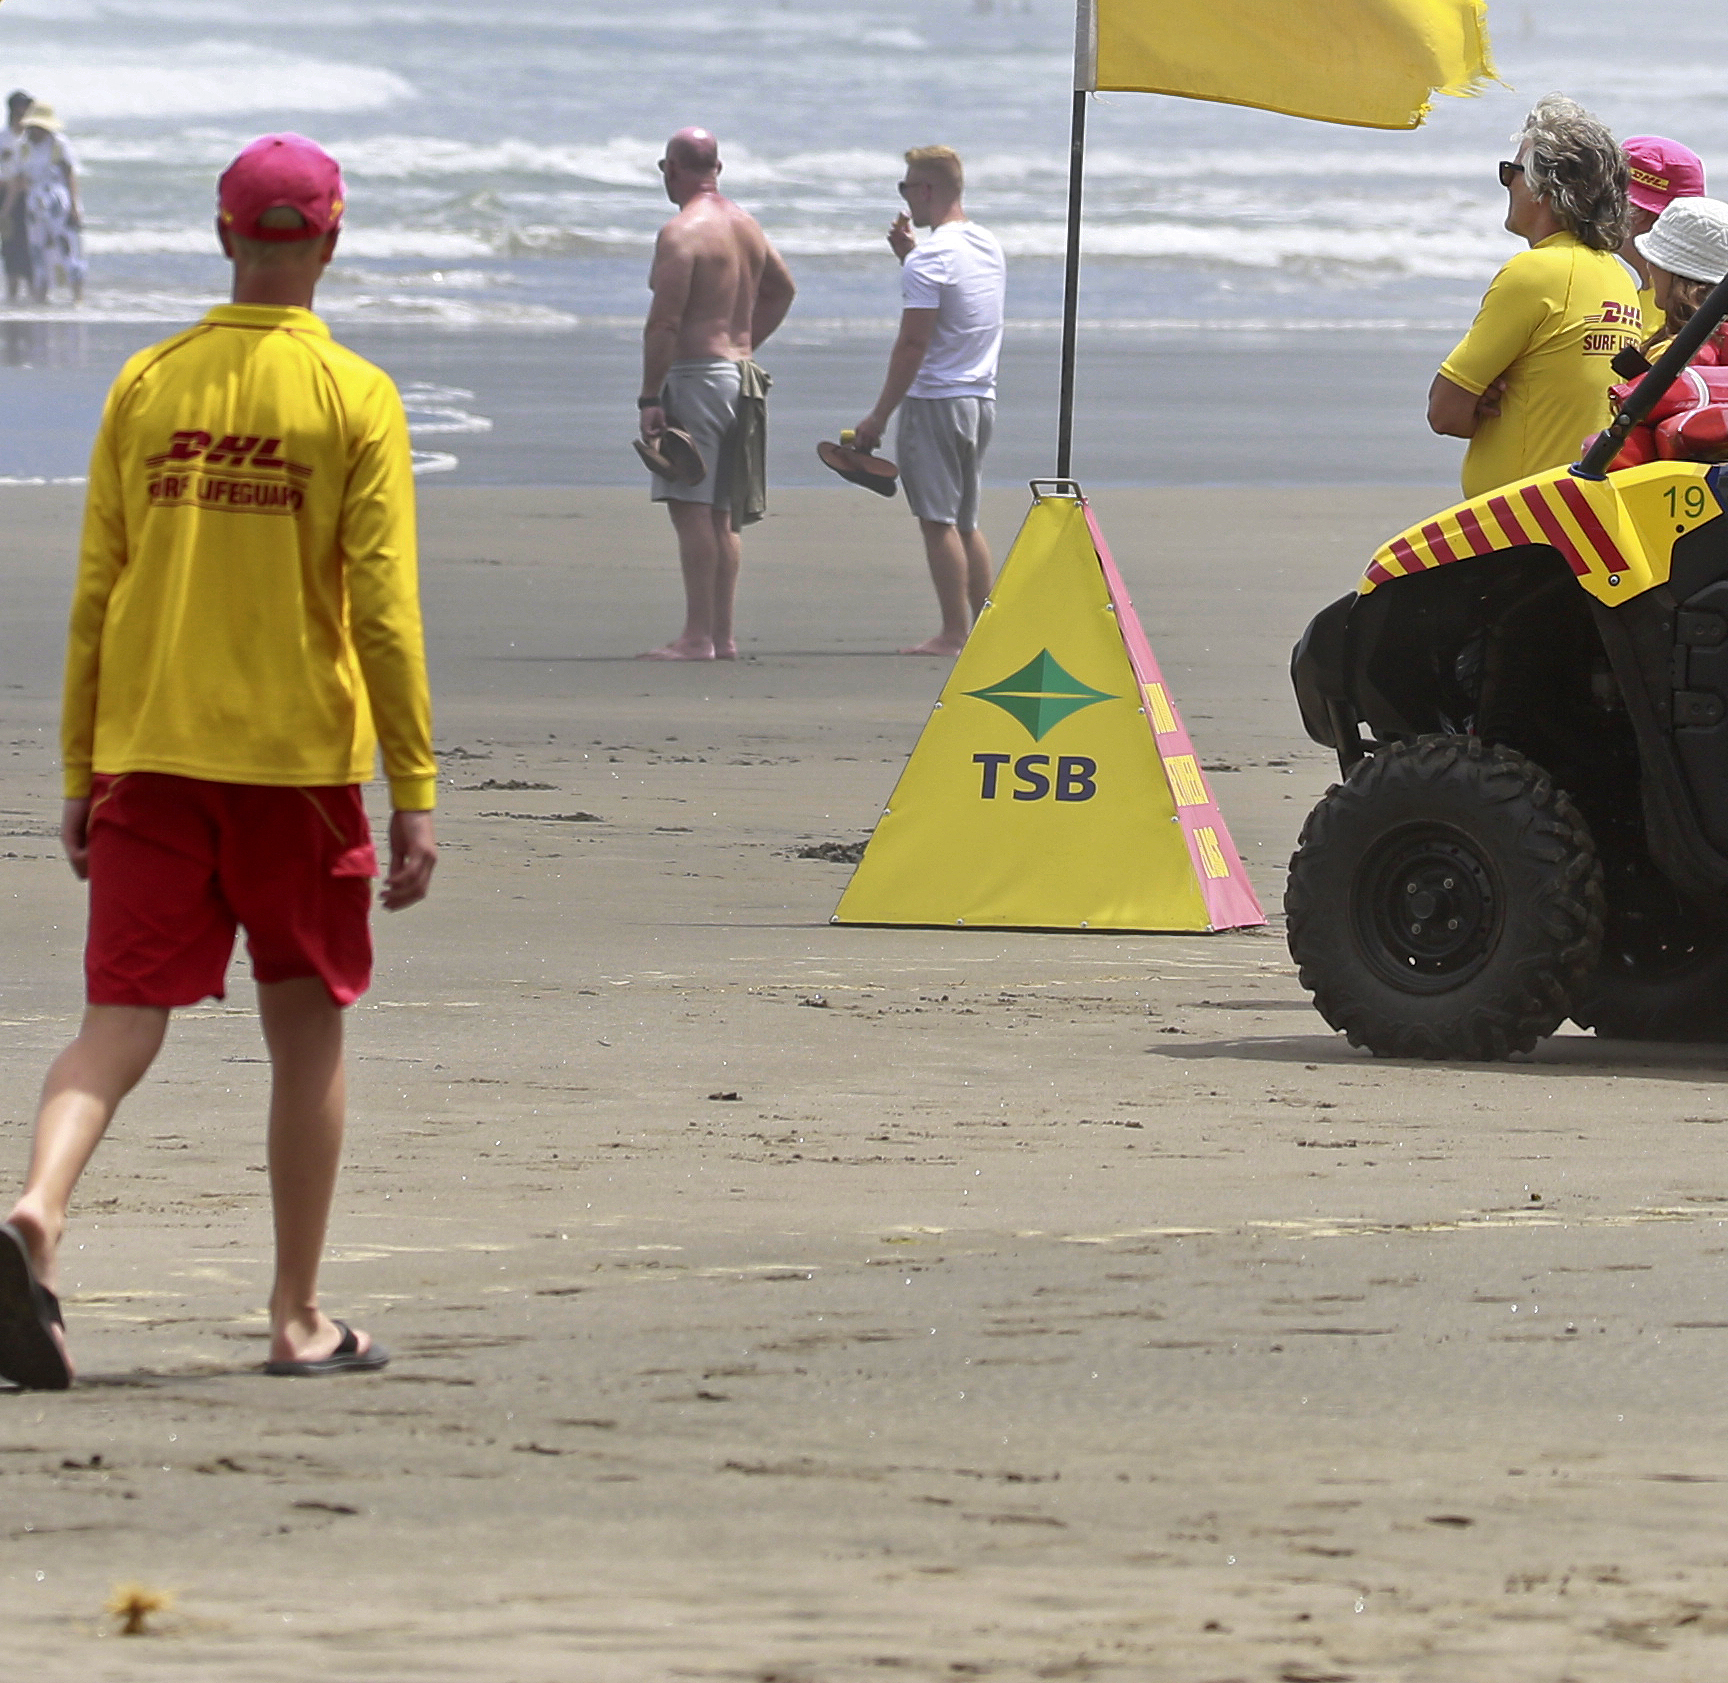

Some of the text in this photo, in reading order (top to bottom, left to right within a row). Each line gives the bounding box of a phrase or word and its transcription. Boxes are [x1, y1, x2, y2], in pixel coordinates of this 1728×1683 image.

[1601, 301, 1643, 329] DHL
[1583, 334, 1616, 350] SURF
[169, 431, 286, 468] DHL
[1663, 486, 1705, 518] 19
[972, 753, 1098, 802] TSB
